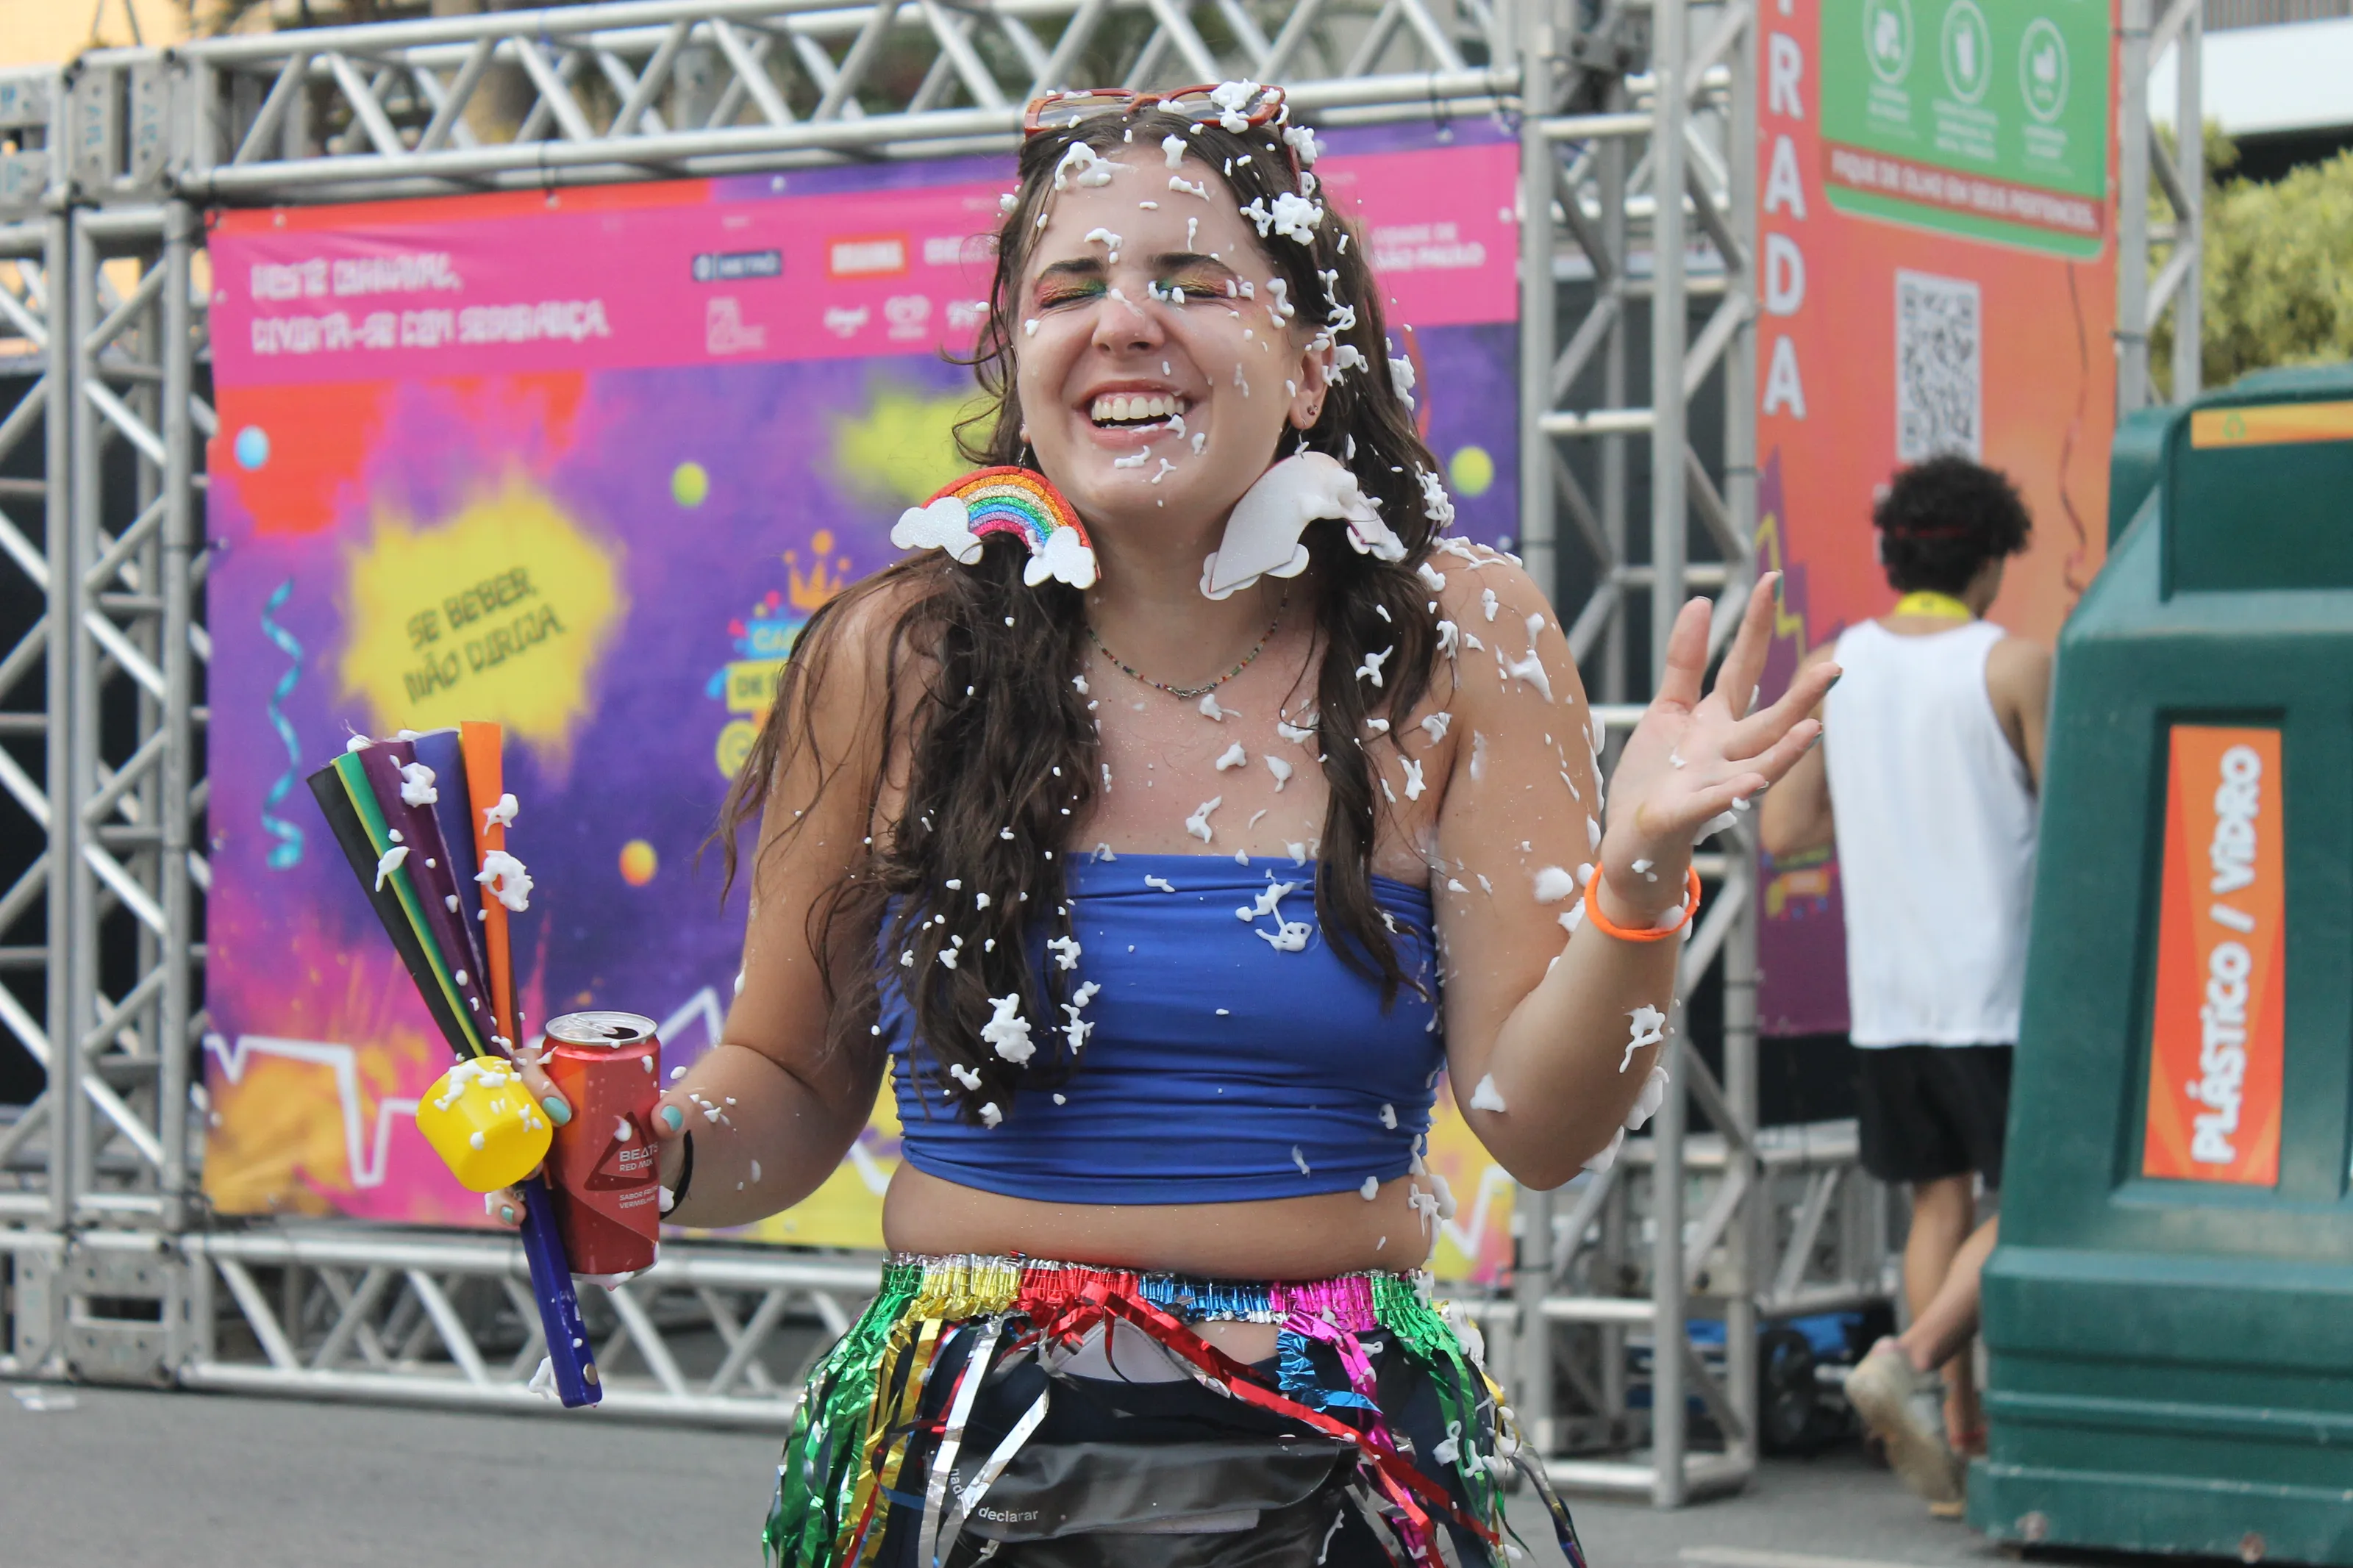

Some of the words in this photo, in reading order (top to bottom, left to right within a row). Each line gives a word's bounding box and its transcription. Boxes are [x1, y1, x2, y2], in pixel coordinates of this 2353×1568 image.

[1763, 0, 1807, 420] RADA
[406, 608, 440, 651] SE
[403, 651, 460, 705] NÃO
[2209, 902, 2256, 934] /
[2186, 941, 2252, 1164] PLÁSTICO
[619, 1142, 659, 1162] BEATS
[619, 1163, 638, 1172] RED
[638, 1158, 654, 1169] MIX
[619, 1191, 643, 1201] SABOR
[978, 1507, 1039, 1522] declarar
